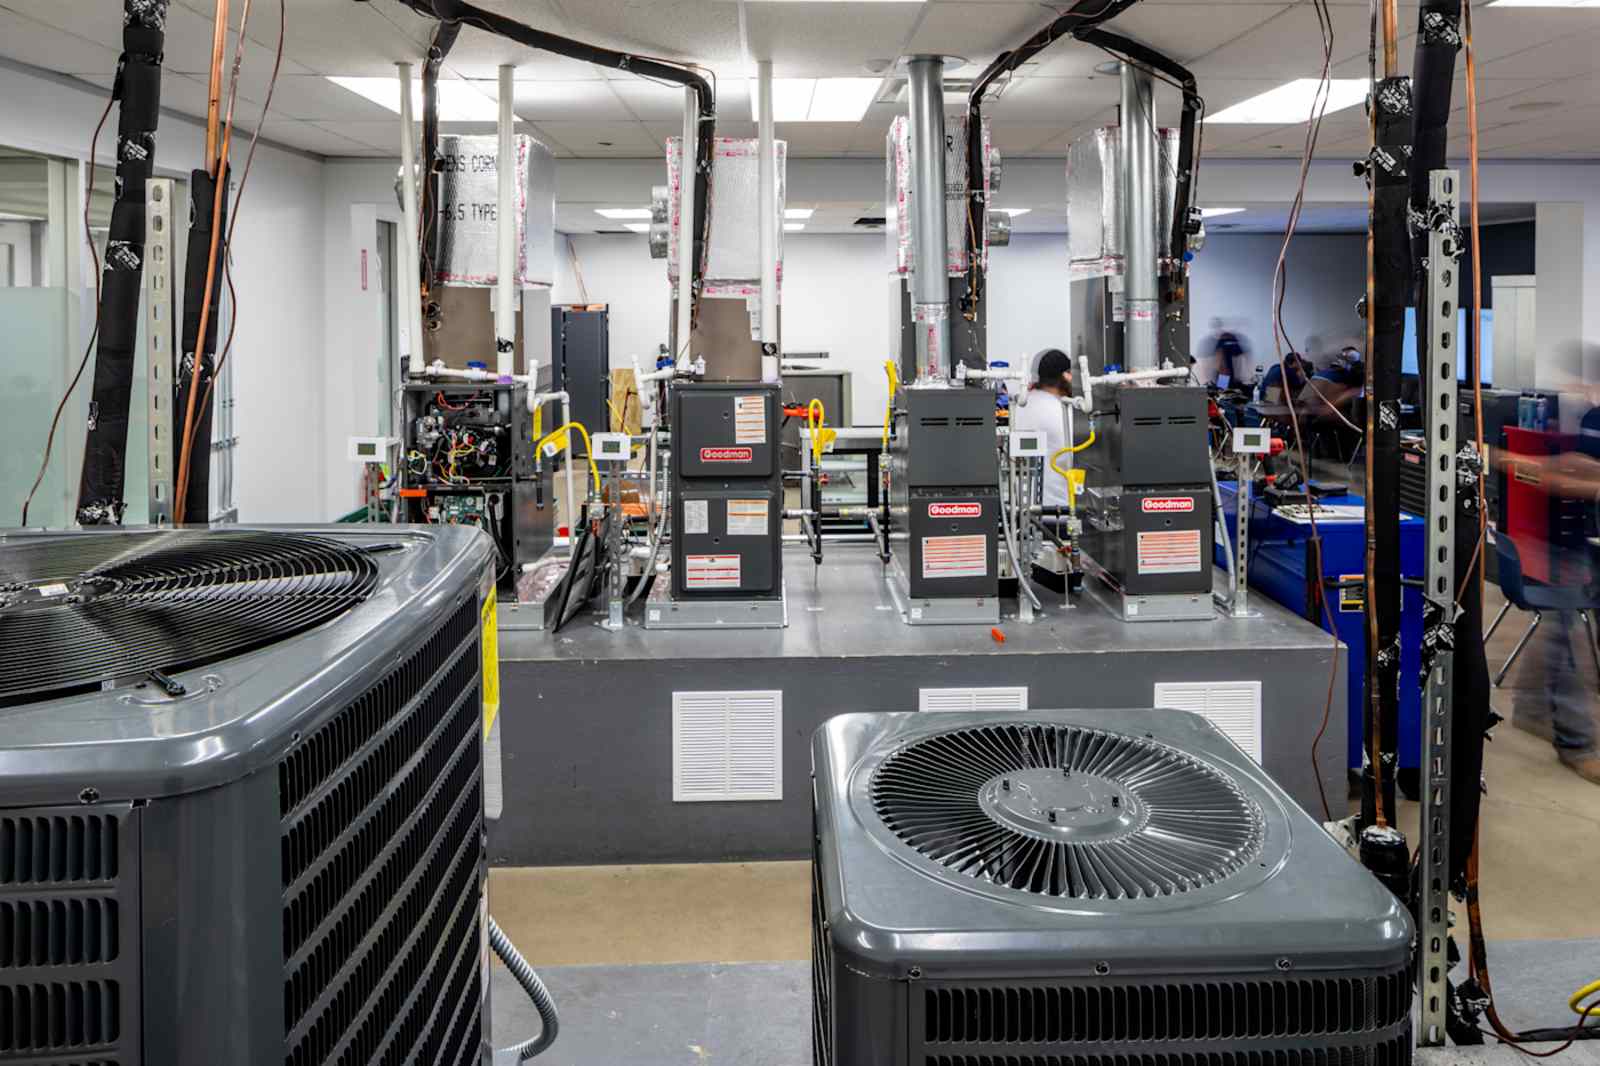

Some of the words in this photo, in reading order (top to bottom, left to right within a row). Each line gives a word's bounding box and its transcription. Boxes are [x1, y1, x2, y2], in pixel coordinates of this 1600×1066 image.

[703, 449, 750, 459] Goodman
[1144, 498, 1191, 509] Goodman
[931, 504, 979, 514] Goodman
